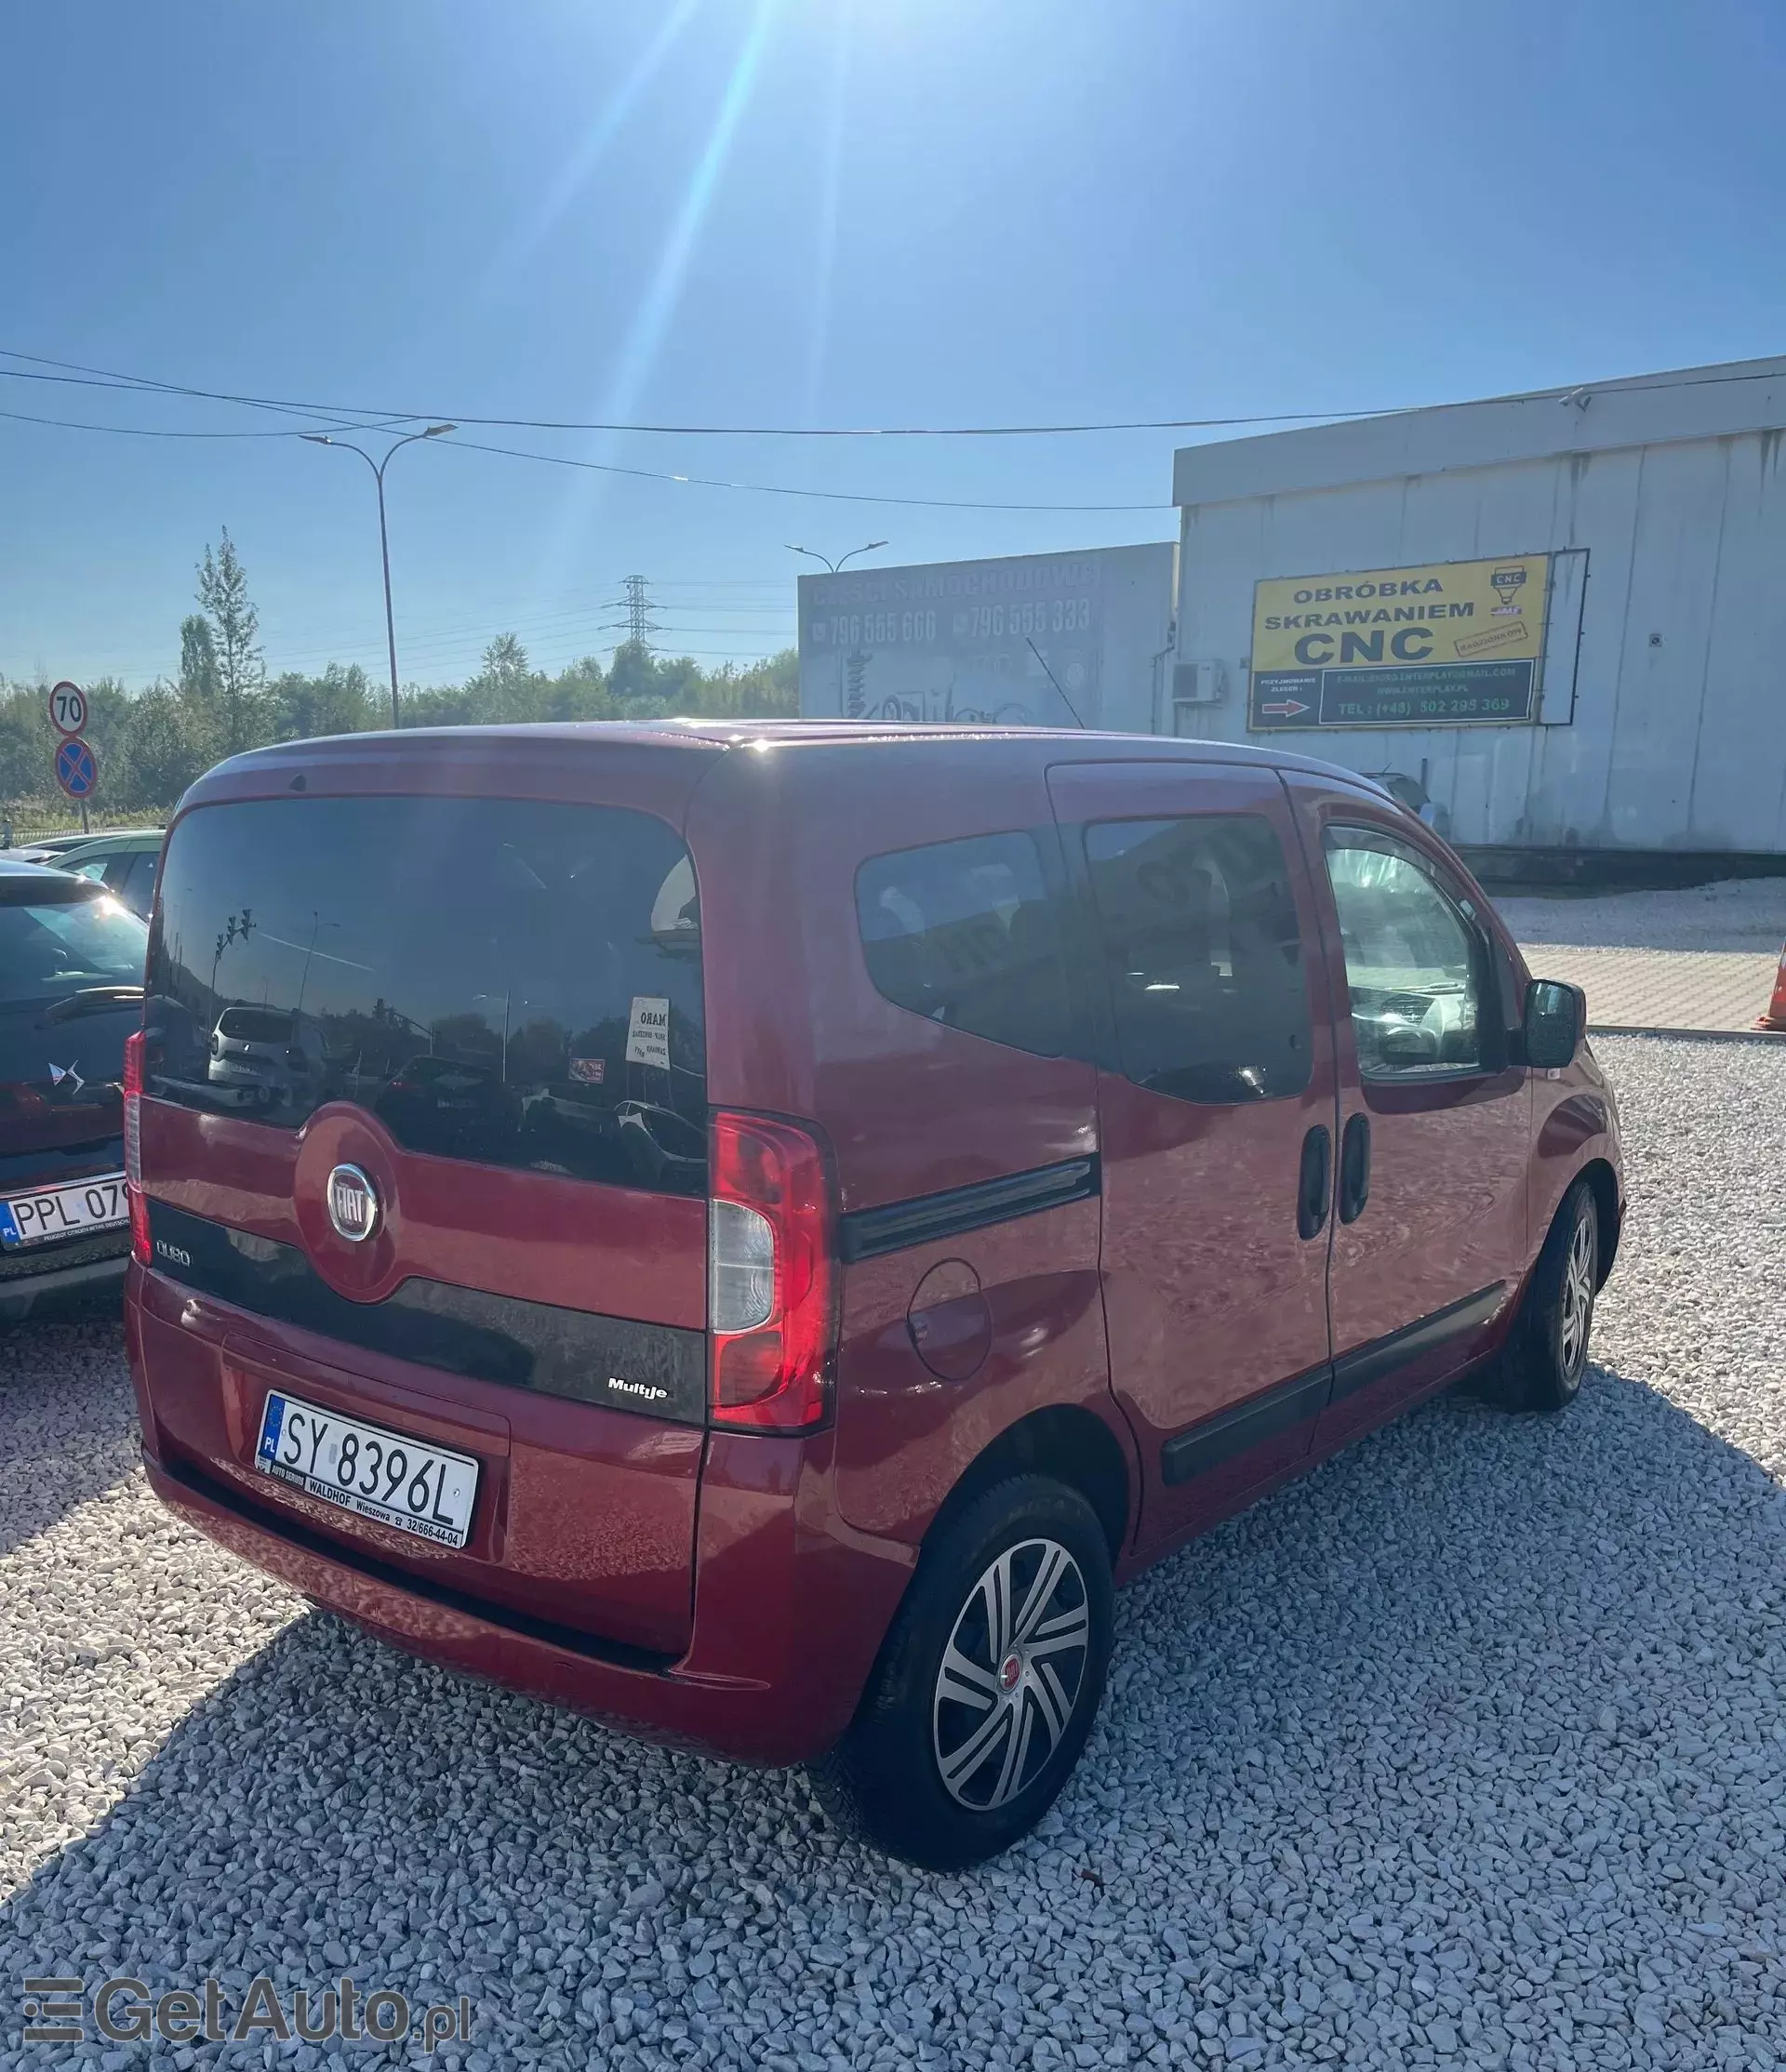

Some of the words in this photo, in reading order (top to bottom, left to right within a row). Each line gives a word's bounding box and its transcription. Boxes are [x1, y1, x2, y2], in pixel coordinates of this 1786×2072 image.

[1293, 578, 1444, 604] OBRÓBKA
[1495, 572, 1521, 585] CNC
[831, 615, 860, 645] 796
[864, 612, 896, 644] 555
[970, 604, 1004, 638] 796
[1009, 601, 1046, 634] 555
[1052, 597, 1090, 631] 333
[1264, 602, 1475, 631] SKRAWANIEM
[1294, 627, 1434, 665] CNC
[56, 696, 82, 723] 70
[13, 1196, 81, 1235] PPL
[336, 1184, 364, 1223] FIAT
[3, 1228, 17, 1237] PL
[264, 1436, 276, 1454] PL
[283, 1413, 328, 1474] SY
[337, 1433, 454, 1525] 8396L
[271, 1465, 285, 1478] AUTO
[309, 1480, 352, 1507] WALDHOF
[356, 1499, 391, 1521] Wieszowa
[407, 1518, 459, 1546] 32/666-44-04
